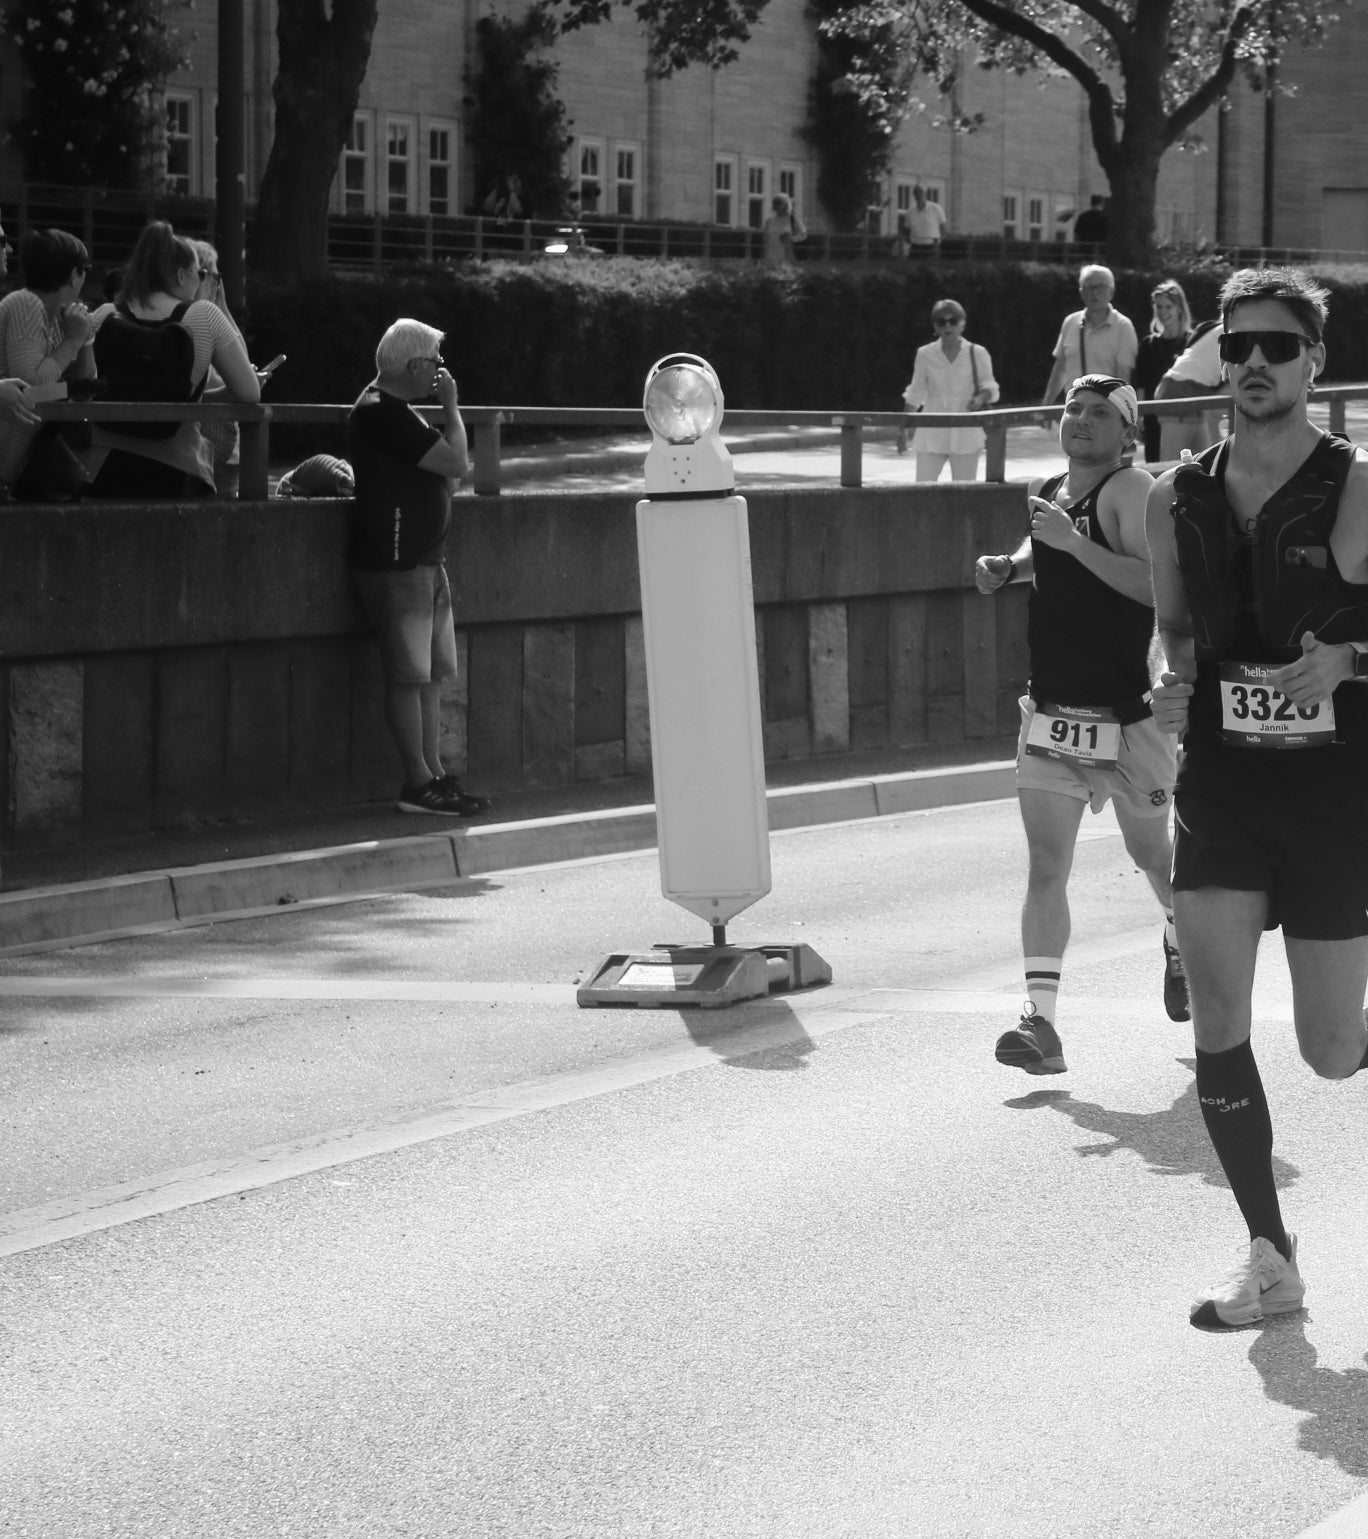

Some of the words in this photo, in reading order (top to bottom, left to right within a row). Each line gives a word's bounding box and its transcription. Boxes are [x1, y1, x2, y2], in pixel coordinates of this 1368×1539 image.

[1244, 665, 1267, 678] hella
[1260, 723, 1290, 732] Jannik
[1049, 719, 1098, 750] 911
[1246, 735, 1261, 743] hella
[1054, 743, 1072, 754] Dean
